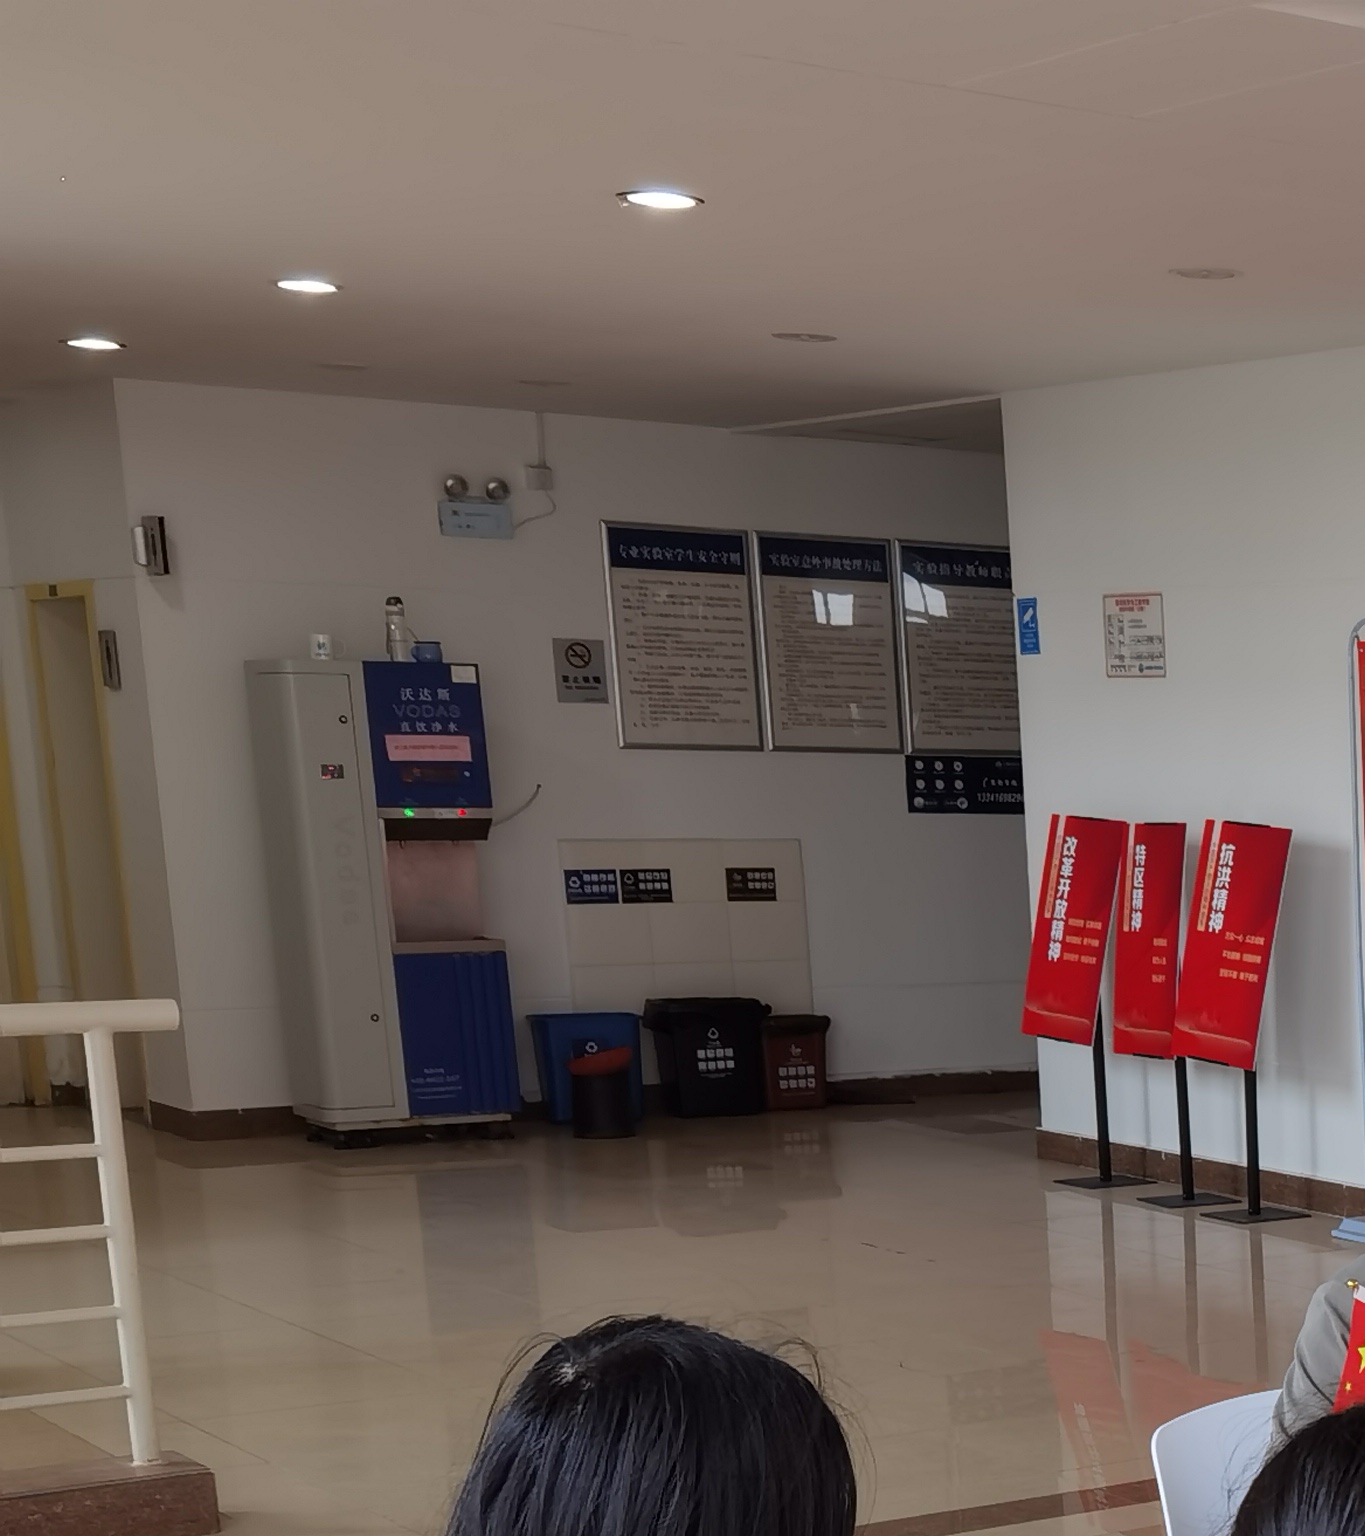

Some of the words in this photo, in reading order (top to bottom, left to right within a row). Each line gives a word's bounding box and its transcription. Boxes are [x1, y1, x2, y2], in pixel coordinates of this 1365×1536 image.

[392, 704, 462, 718] VODAS
[1131, 844, 1147, 933] 特区精神
[1208, 843, 1236, 933] 抗洪精神
